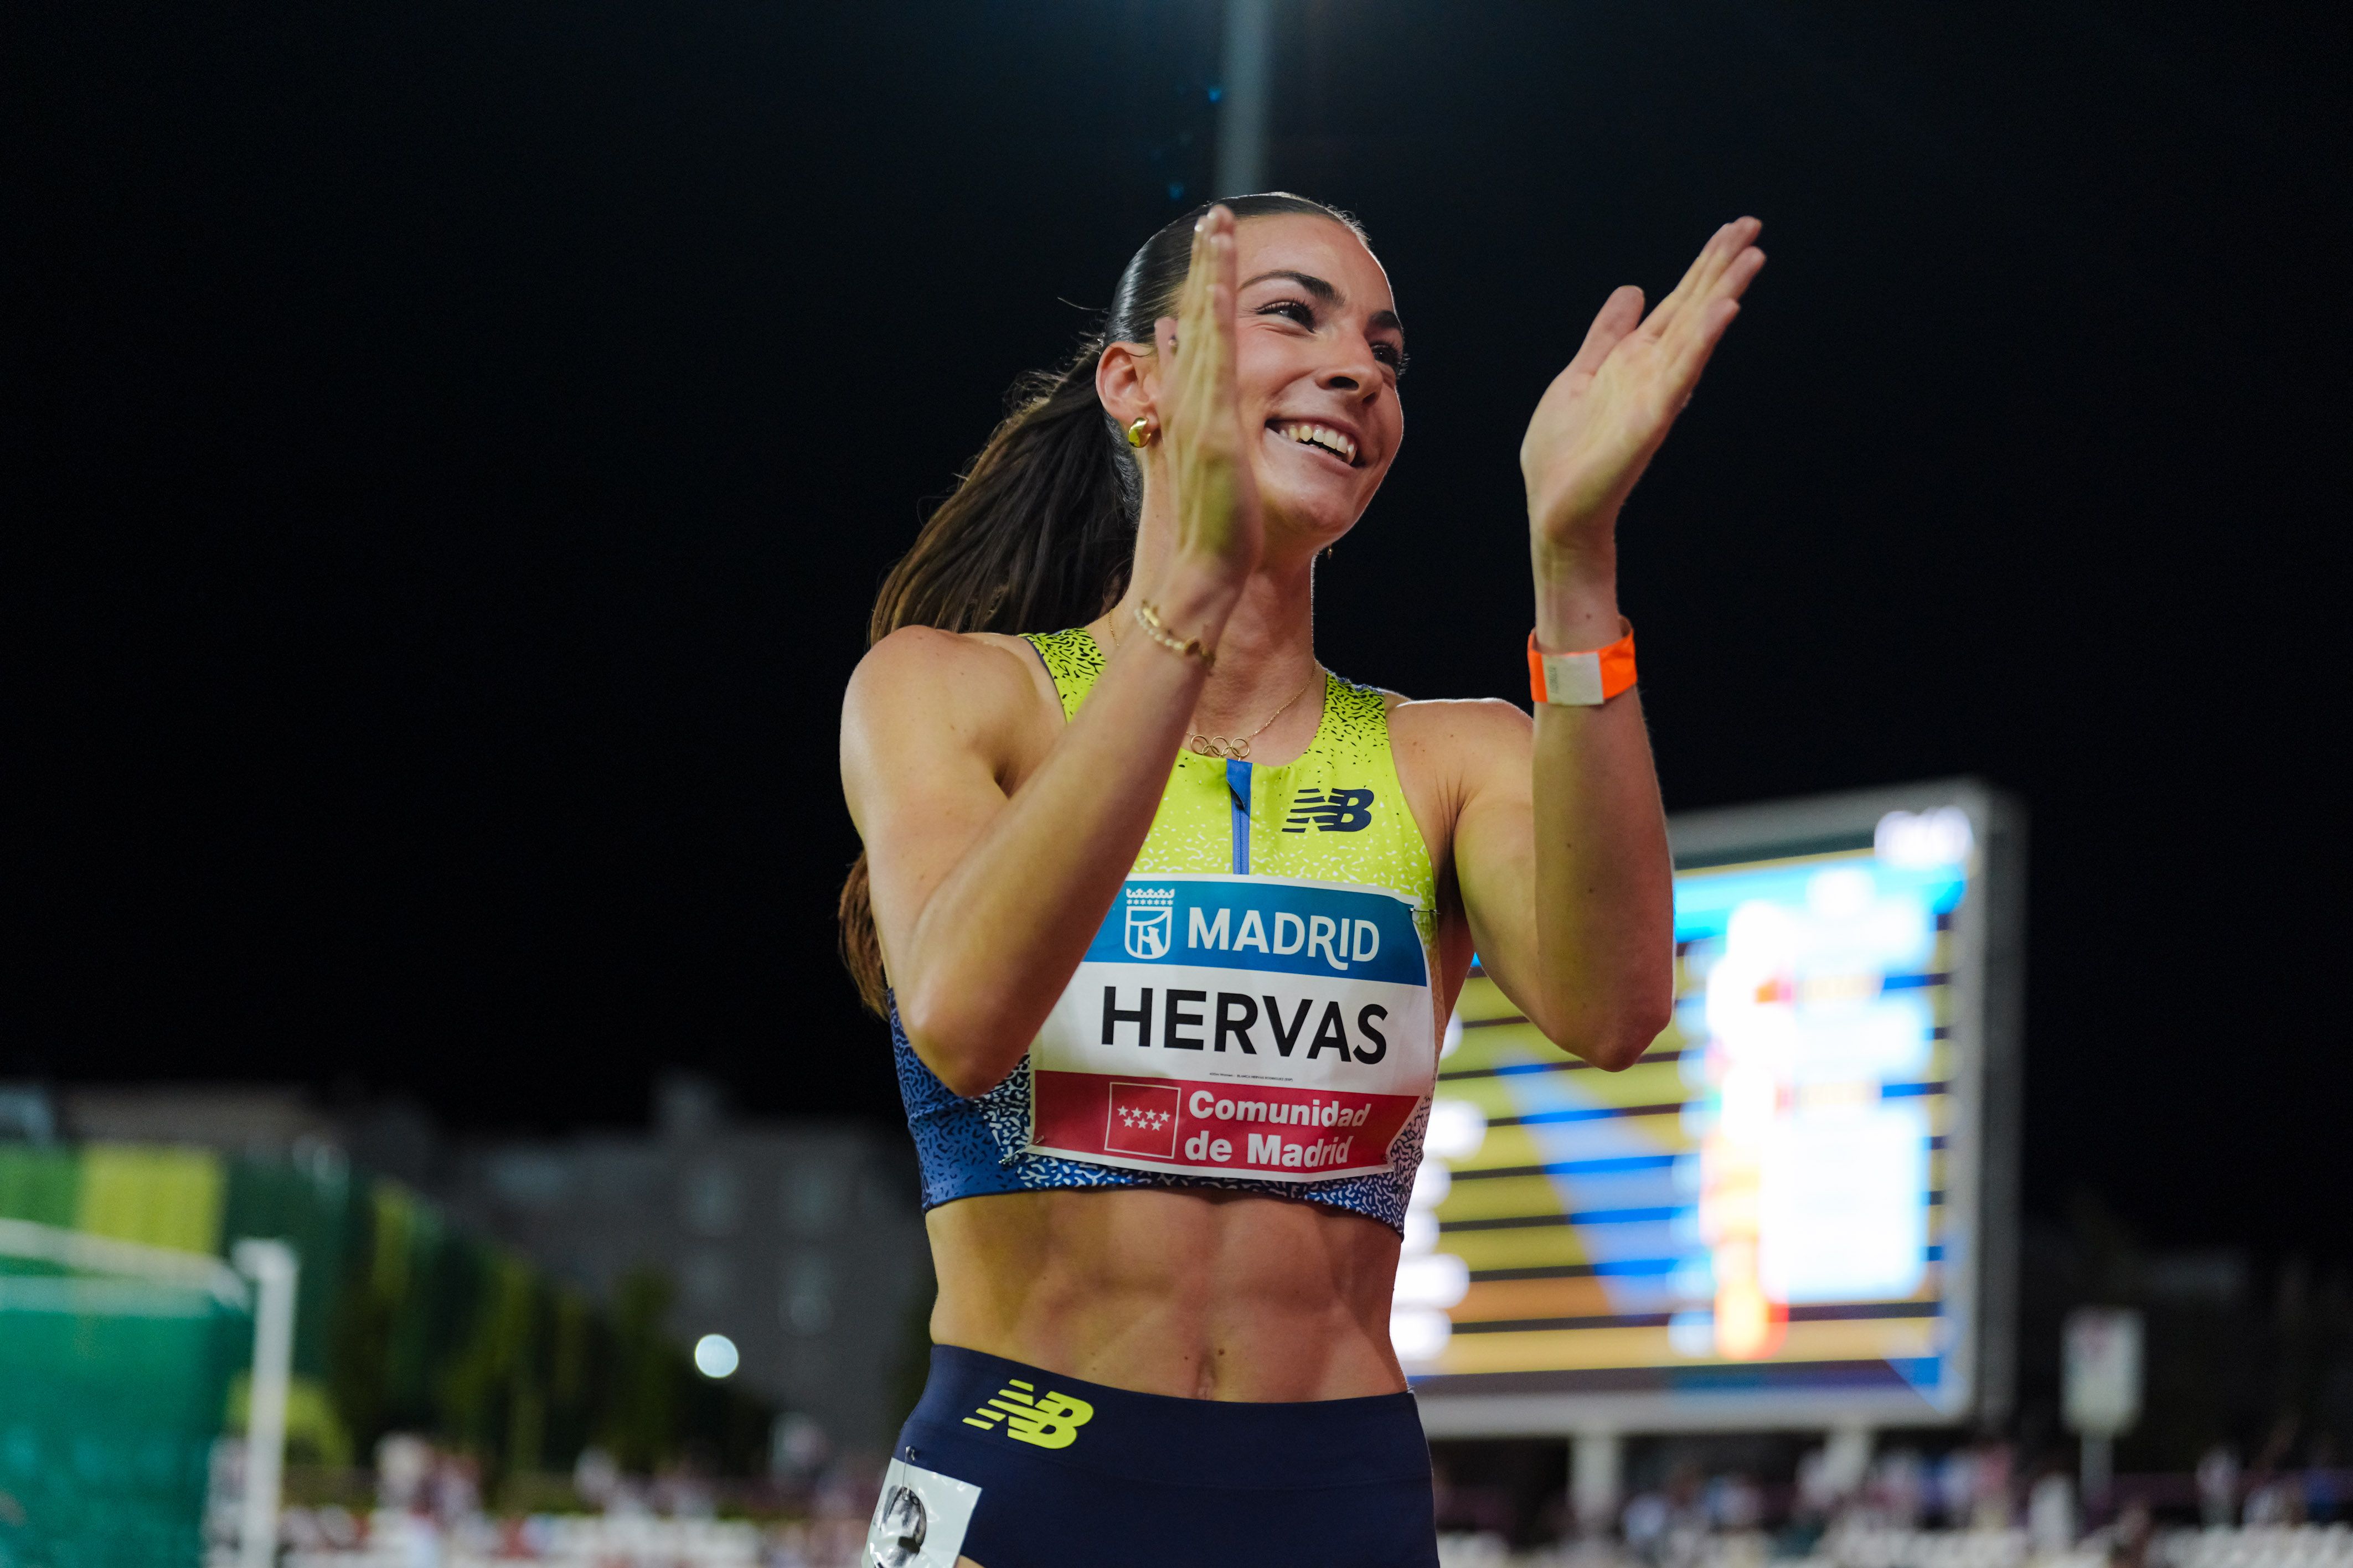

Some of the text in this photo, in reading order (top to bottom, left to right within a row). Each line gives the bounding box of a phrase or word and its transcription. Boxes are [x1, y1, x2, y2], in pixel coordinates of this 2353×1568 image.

[1188, 907, 1380, 971] MADRID
[1101, 986, 1389, 1065] HERVAS
[1189, 1090, 1371, 1128] Comunidad
[1184, 1130, 1353, 1168] de Madrid
